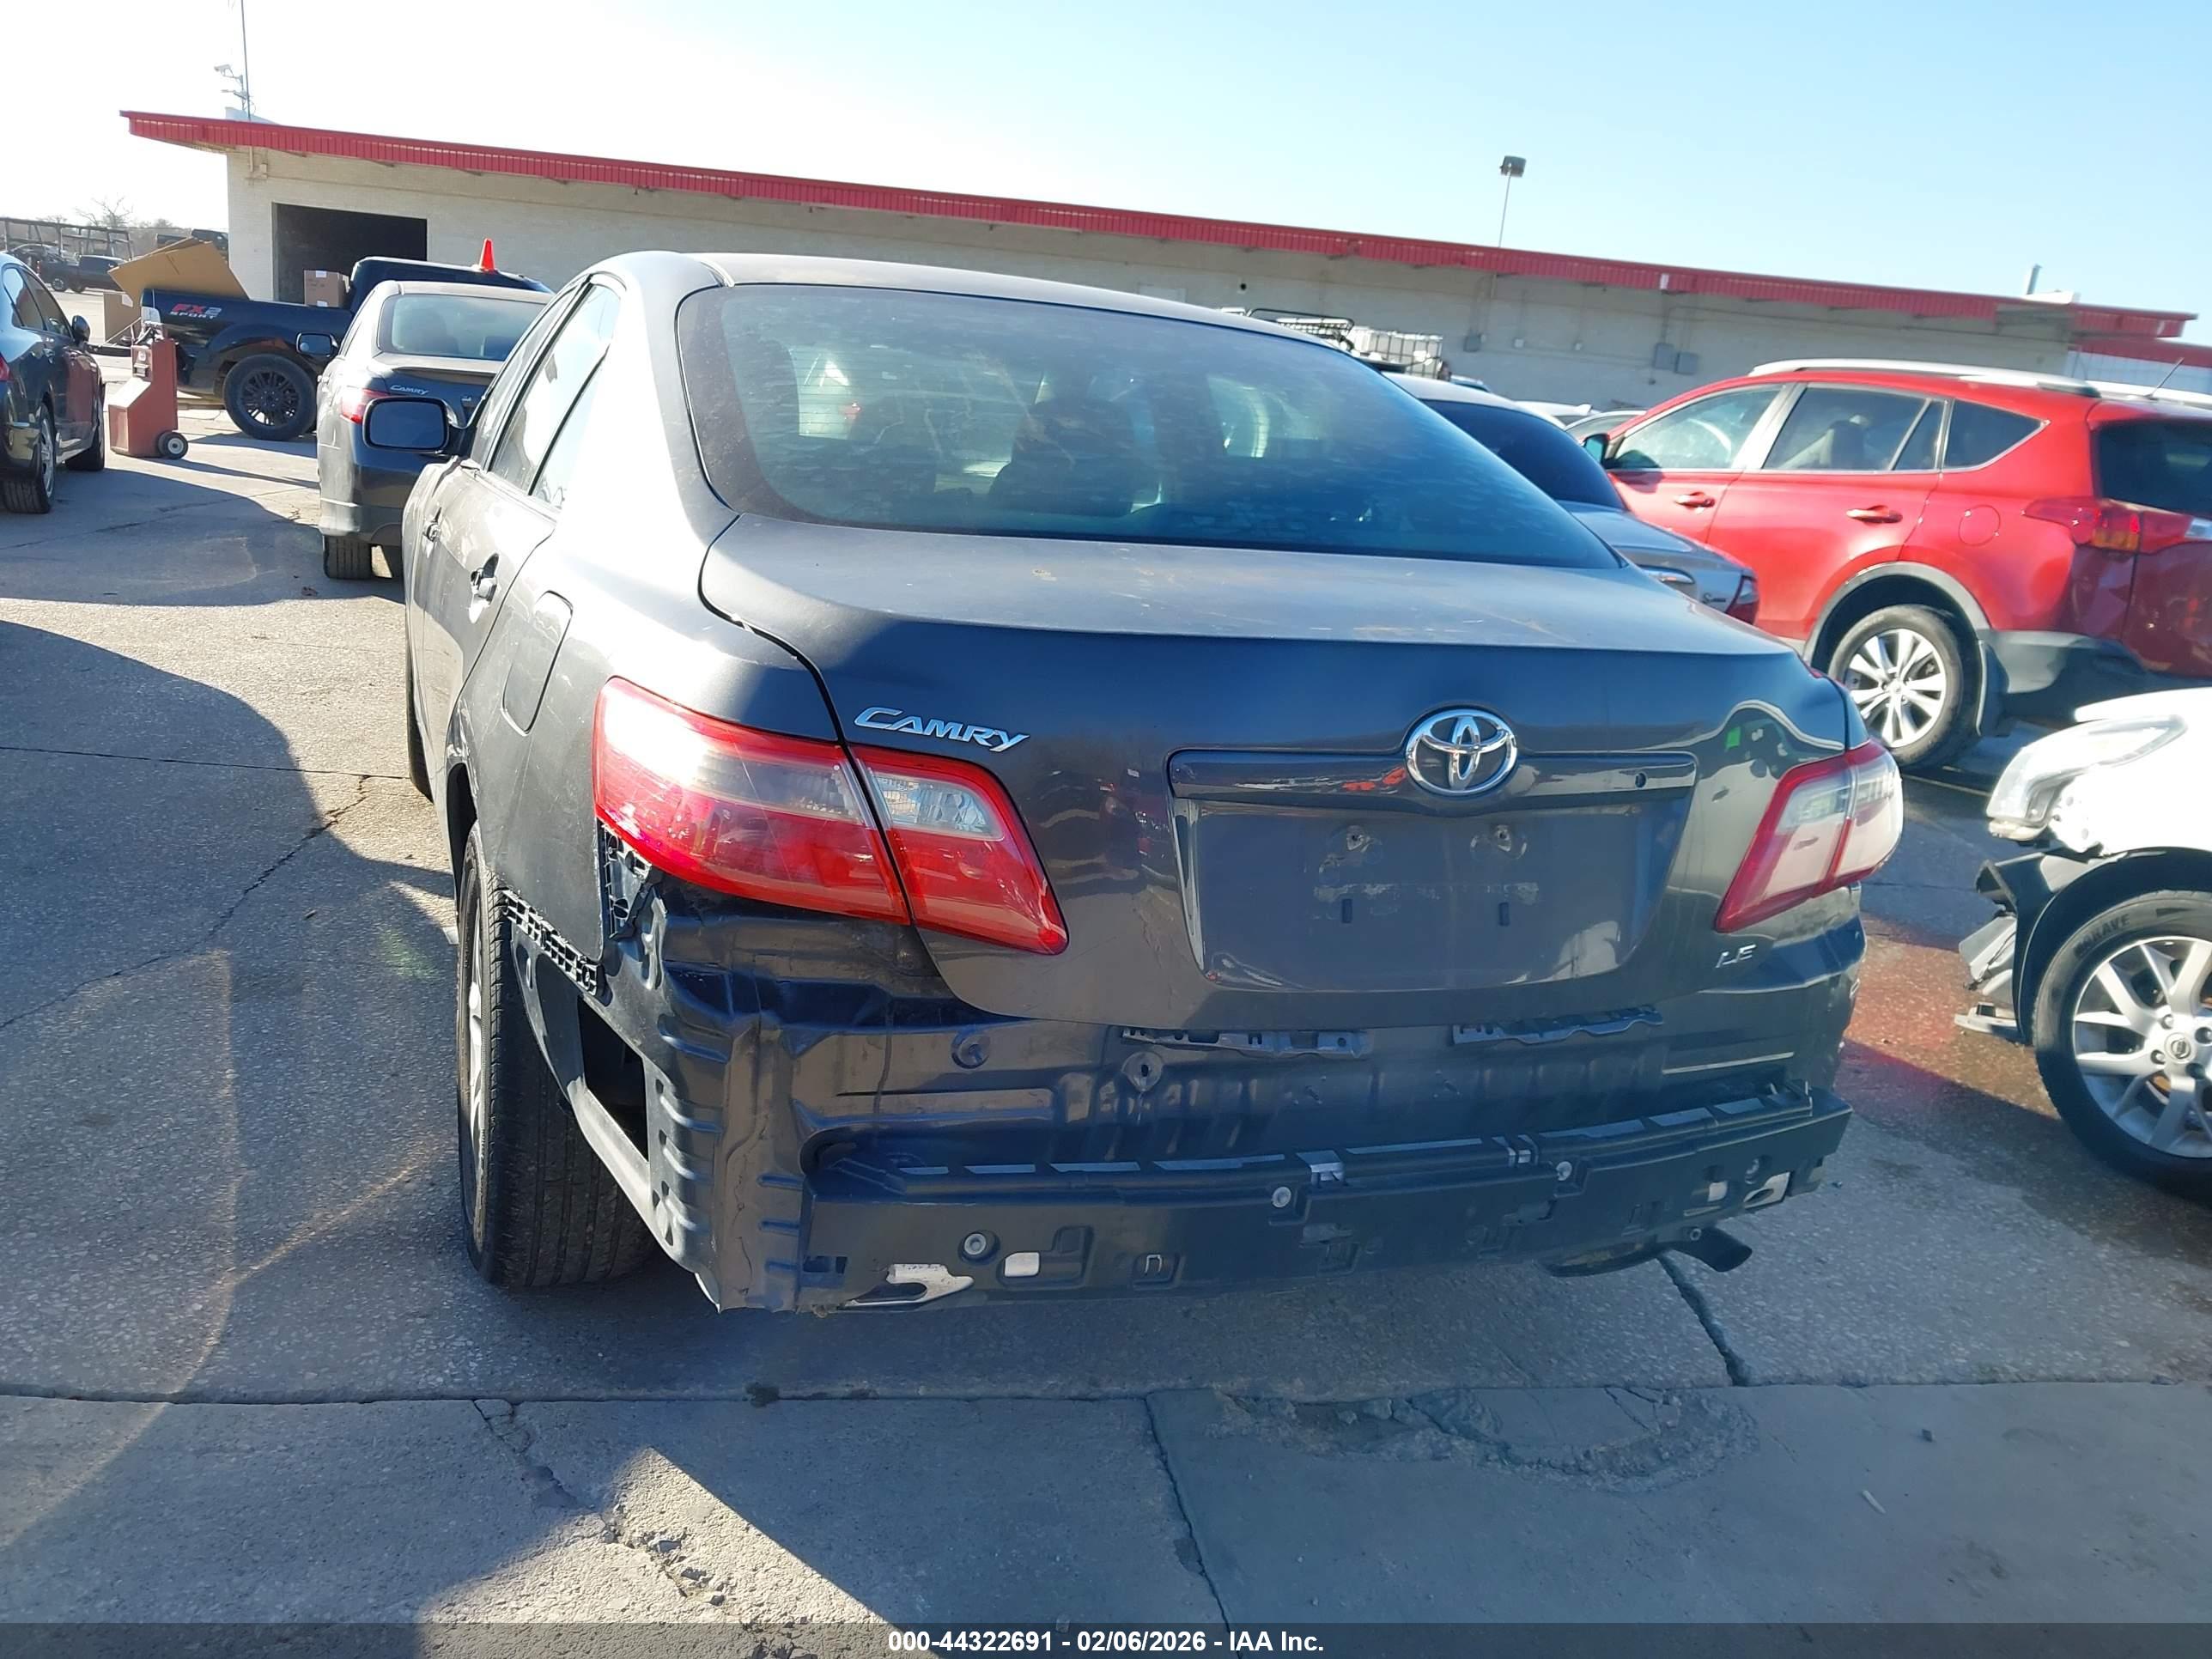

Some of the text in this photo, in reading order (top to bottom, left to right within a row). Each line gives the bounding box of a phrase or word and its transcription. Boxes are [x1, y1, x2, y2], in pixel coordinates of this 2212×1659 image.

[170, 311, 215, 319] SPORT
[172, 303, 222, 317] FX2
[390, 385, 429, 395] CAMRY
[854, 707, 1030, 752] CAMRY
[1715, 944, 1758, 969] LE
